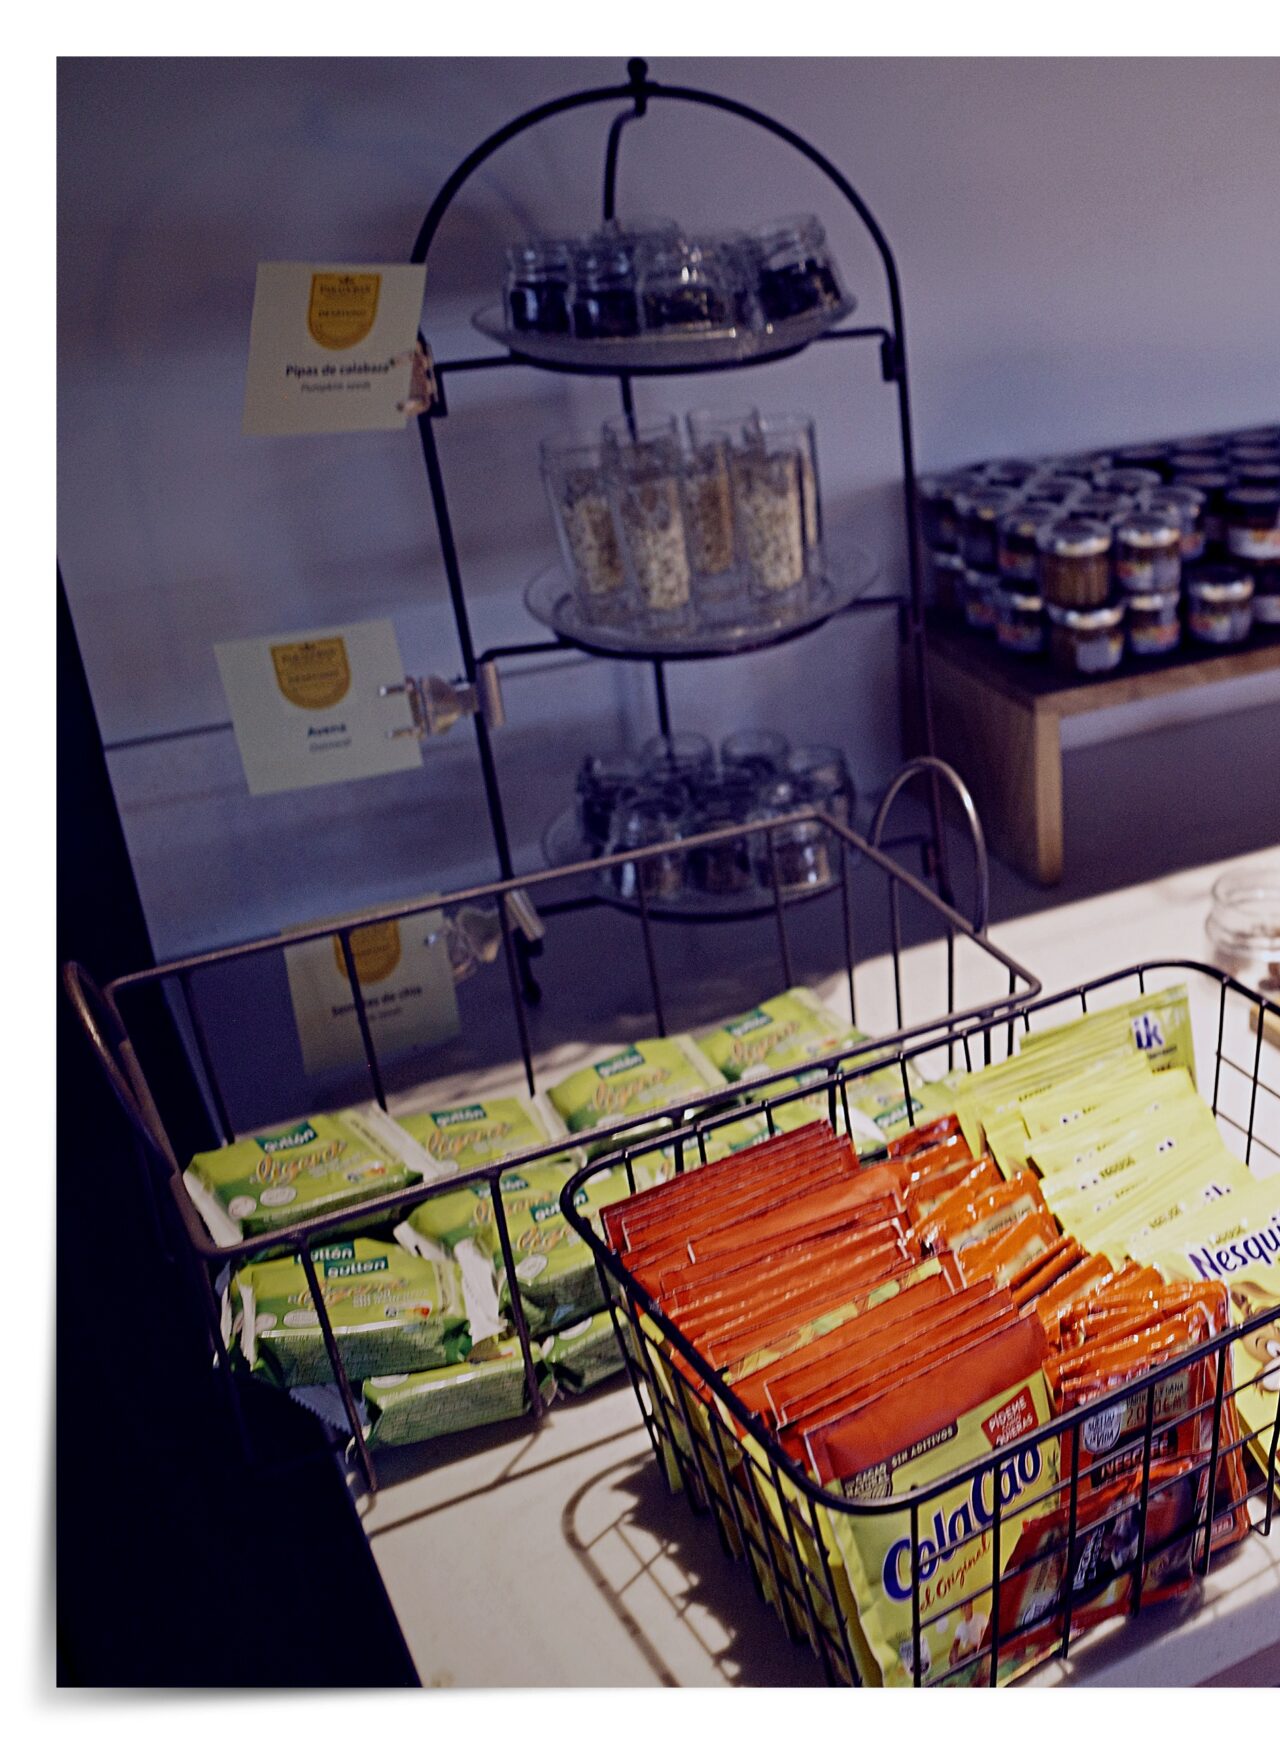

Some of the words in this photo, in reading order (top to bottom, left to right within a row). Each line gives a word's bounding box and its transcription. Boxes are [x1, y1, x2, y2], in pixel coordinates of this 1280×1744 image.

[321, 364, 337, 376] de
[891, 1449, 909, 1469] SIN
[911, 1424, 954, 1459] ADITIVOS
